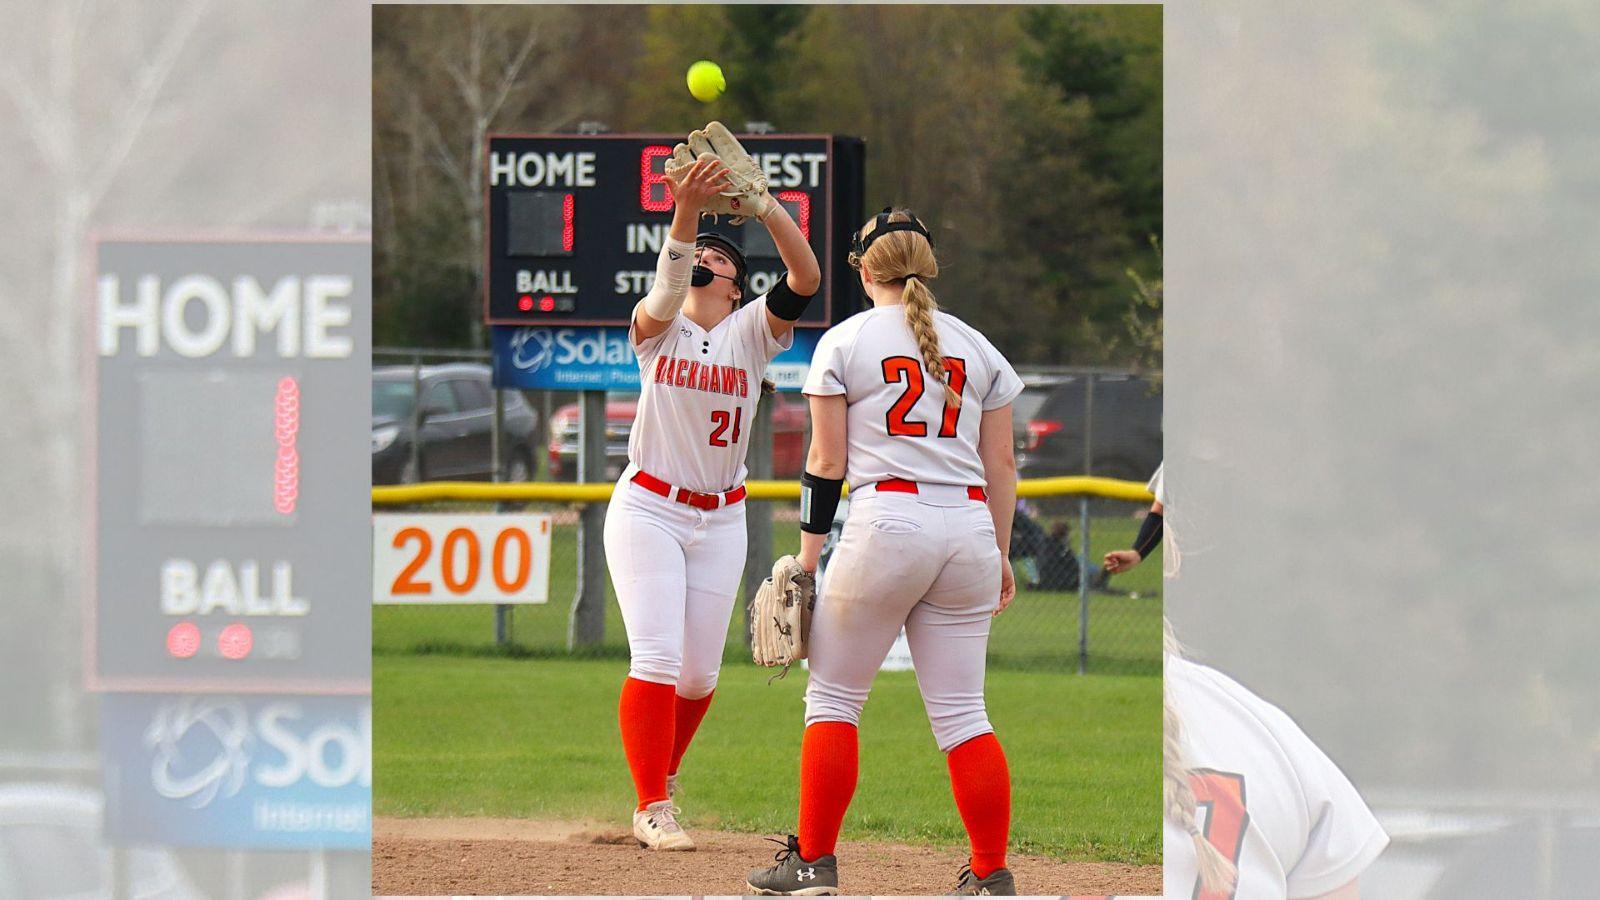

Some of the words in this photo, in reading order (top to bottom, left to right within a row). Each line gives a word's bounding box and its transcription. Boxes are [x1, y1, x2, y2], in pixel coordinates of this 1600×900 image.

[489, 152, 596, 187] HOME
[641, 145, 675, 212] 6
[753, 153, 827, 187] EST
[563, 193, 575, 251] 1
[516, 270, 578, 294] BALL
[96, 273, 353, 358] HOME
[881, 355, 967, 438] 27
[160, 558, 310, 616] BALL
